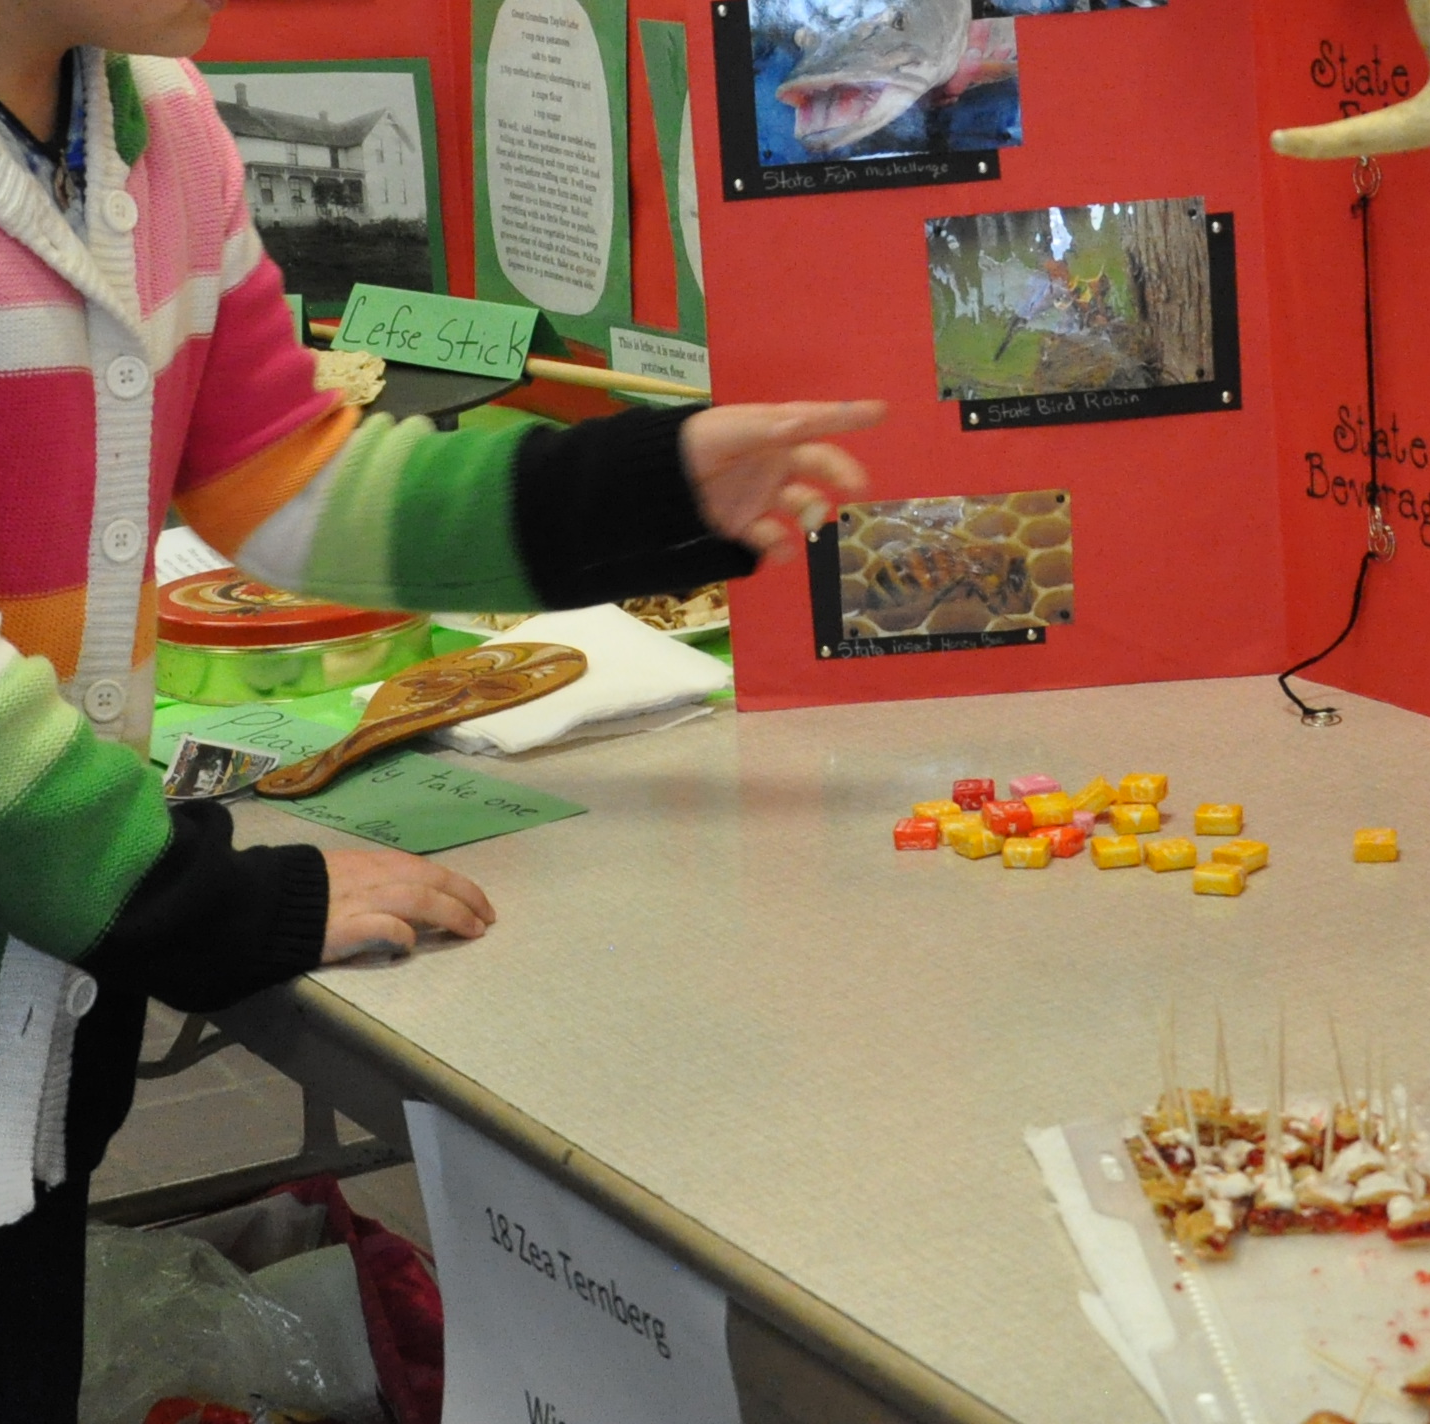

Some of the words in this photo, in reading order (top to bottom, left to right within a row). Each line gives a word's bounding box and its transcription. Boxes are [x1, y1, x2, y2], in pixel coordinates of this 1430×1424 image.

[1310, 39, 1410, 97] State
[762, 171, 817, 191] State
[342, 294, 422, 351] Lefse
[436, 318, 527, 369] Stick
[618, 336, 634, 350] This
[669, 346, 686, 360] made
[686, 349, 697, 362] out
[1036, 396, 1074, 416] Bird
[1084, 392, 1141, 410] Robin
[1334, 405, 1429, 470] State
[419, 768, 477, 800] take
[483, 795, 540, 818] one
[484, 1205, 514, 1255] 18
[514, 1223, 558, 1280] Zea
[557, 1250, 672, 1361] Ternberg
